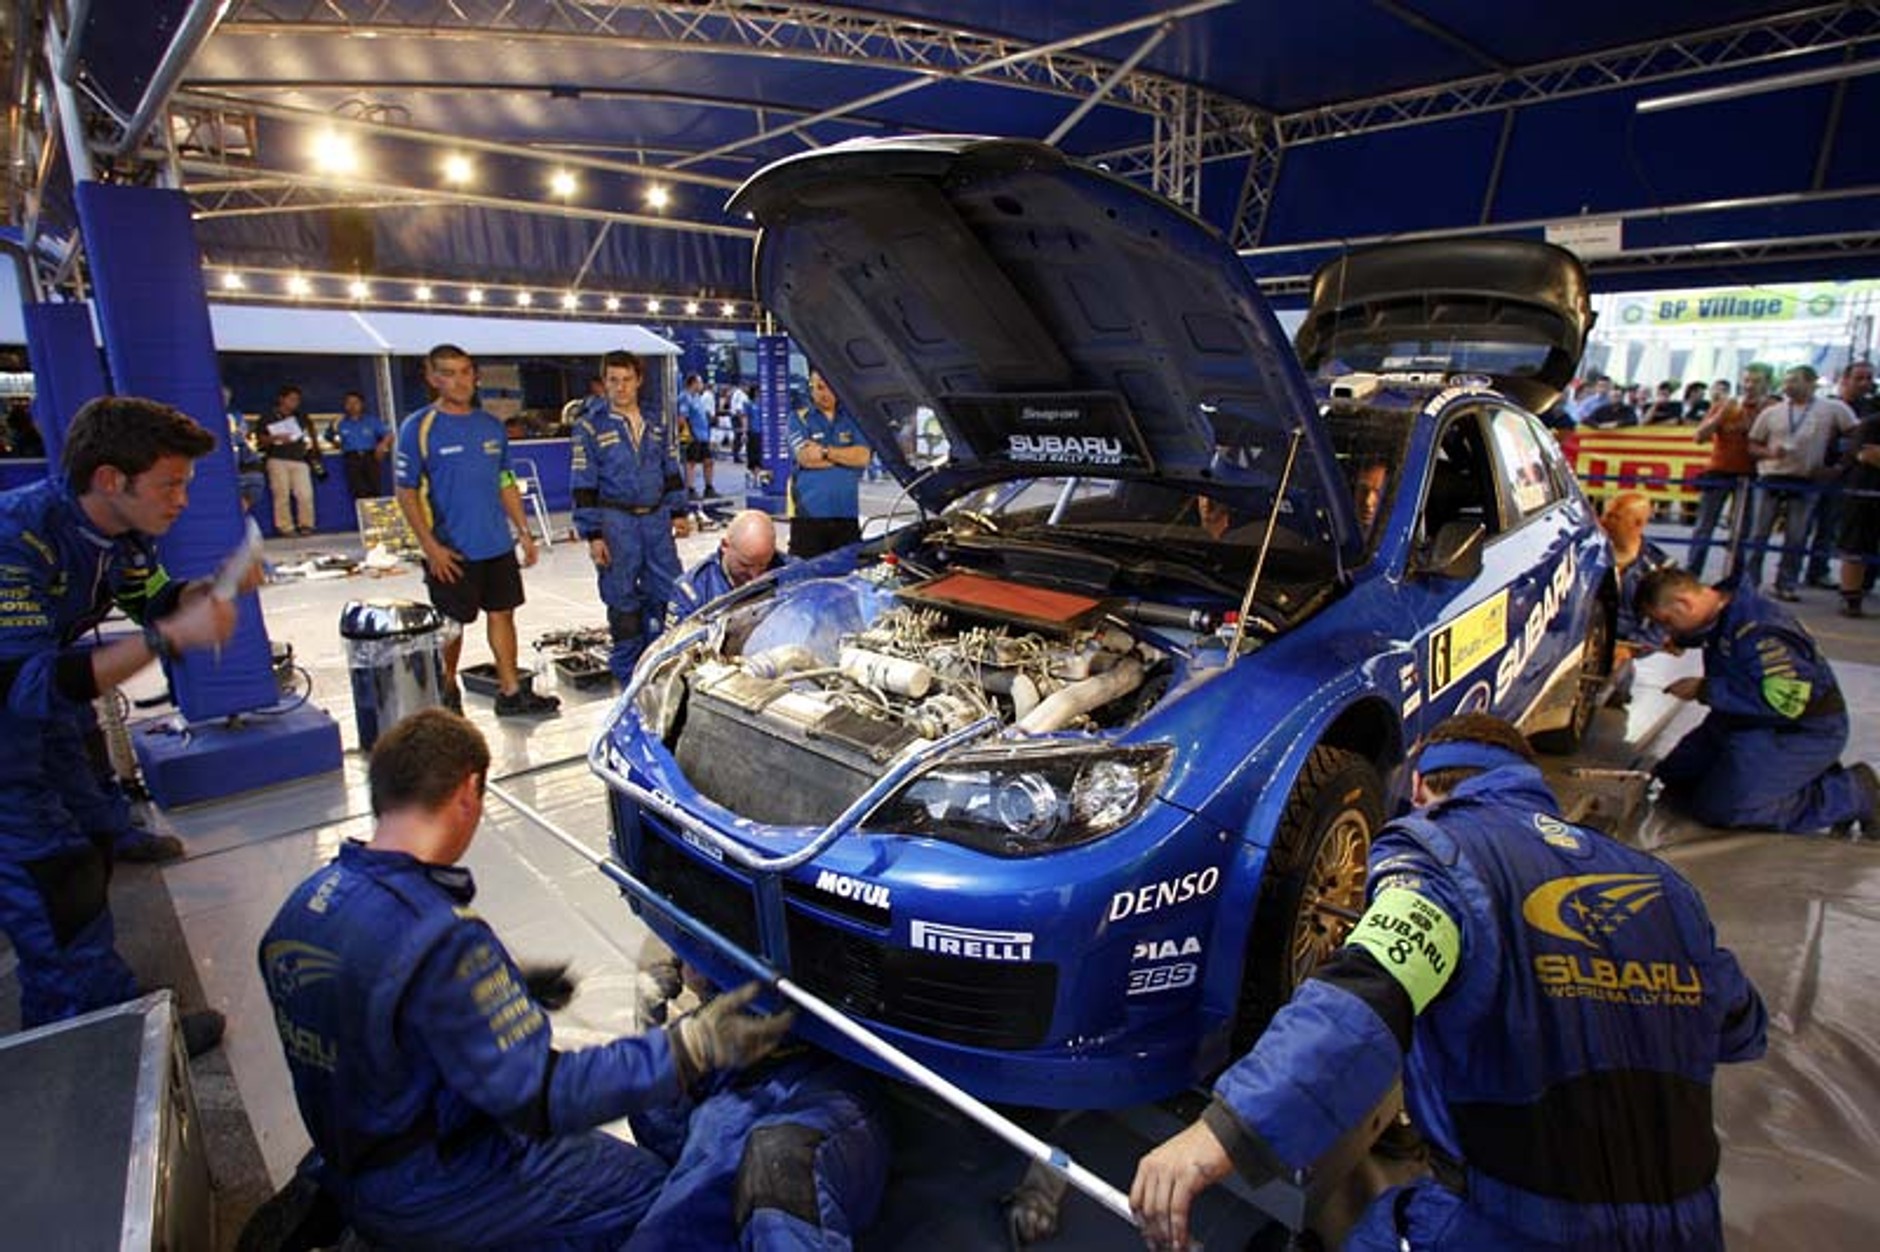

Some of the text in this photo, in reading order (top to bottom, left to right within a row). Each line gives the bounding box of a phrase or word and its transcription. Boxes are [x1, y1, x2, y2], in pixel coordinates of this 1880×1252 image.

[1659, 296, 1782, 319] BP Village
[1008, 434, 1122, 455] SUBARU
[1493, 541, 1577, 706] SUBARU
[1435, 632, 1447, 688] 6
[816, 869, 890, 909] MOTUL
[1109, 866, 1219, 922] DENSO
[910, 918, 1034, 961] PIRELLI
[1367, 913, 1446, 975] SUBARU
[1387, 938, 1414, 965] 8
